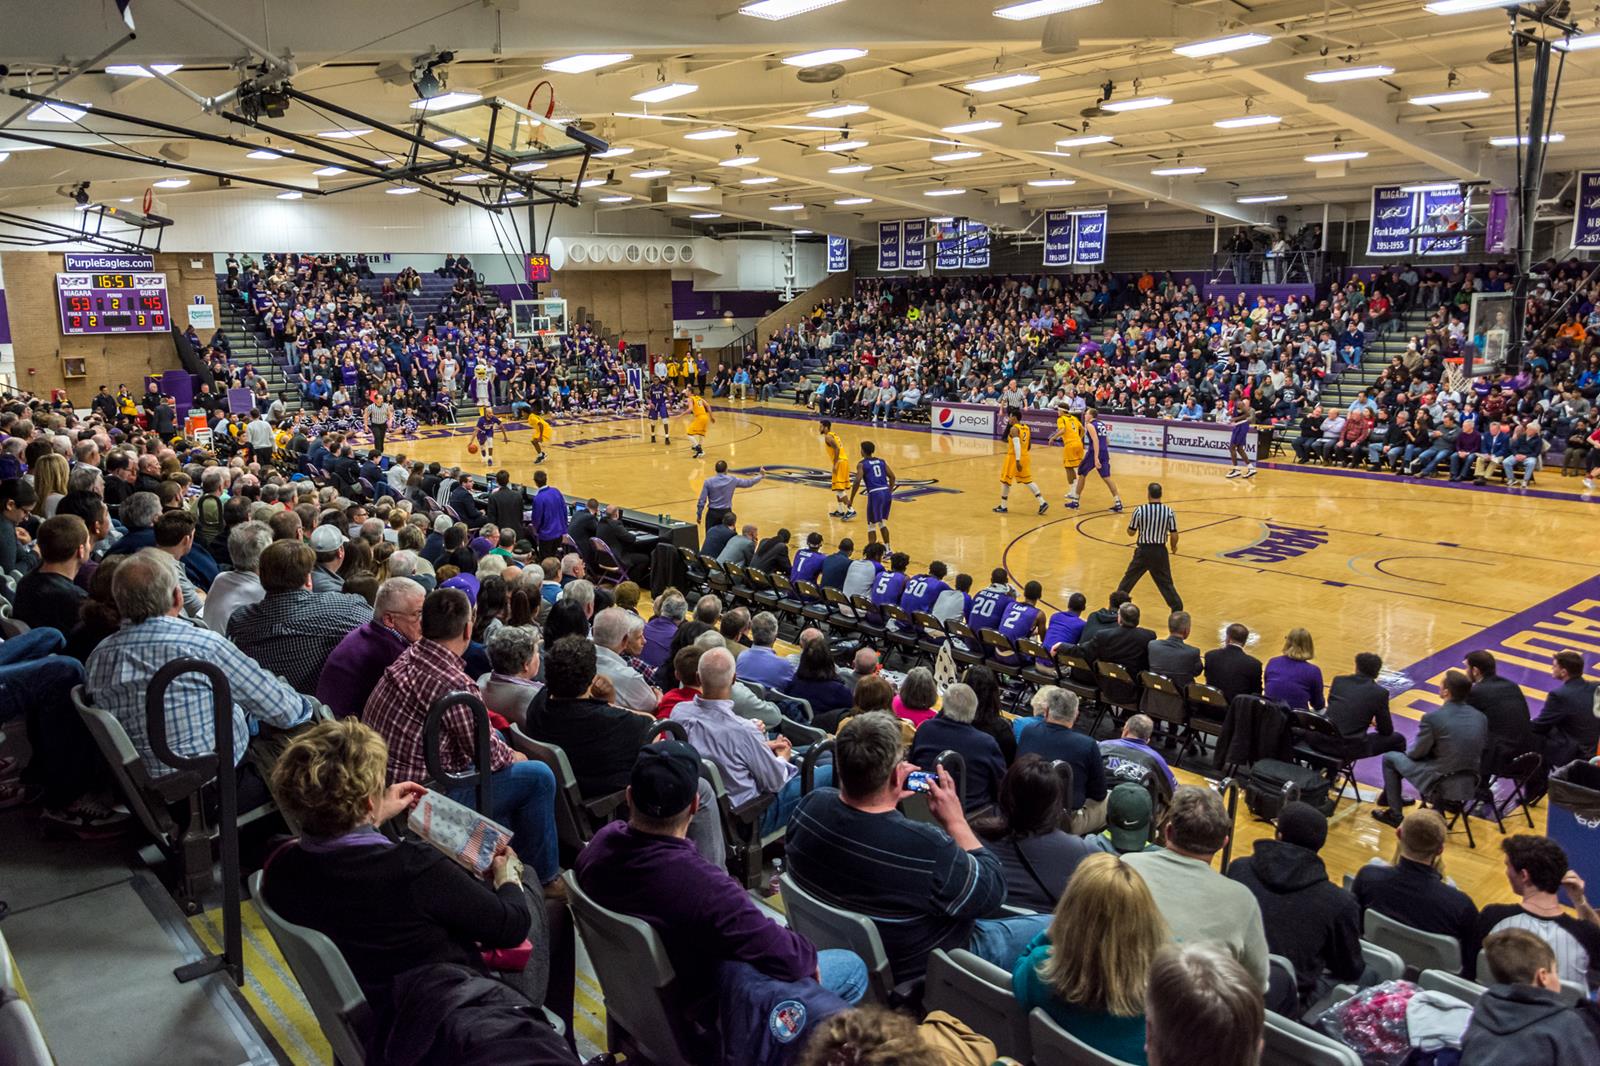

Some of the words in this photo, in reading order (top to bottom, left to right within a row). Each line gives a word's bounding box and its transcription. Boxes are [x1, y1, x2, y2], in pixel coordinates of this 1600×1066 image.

[1374, 227, 1388, 236] Frank
[1389, 227, 1409, 238] Layden
[68, 258, 152, 269] PurpleEagles.com
[346, 255, 380, 263] CEER
[99, 275, 133, 288] 16:51
[71, 297, 91, 311] 53
[112, 299, 119, 309] 2
[143, 297, 162, 310] 45
[73, 316, 80, 327] 2
[89, 316, 97, 326] 2
[138, 315, 145, 326] 3
[155, 314, 162, 325] 0
[959, 414, 989, 426] pepsi
[1097, 424, 1108, 436] 32
[1167, 433, 1256, 453] PURPLEEAGLESM
[873, 465, 881, 477] 0
[876, 578, 889, 594] 5
[905, 580, 928, 597] 30
[972, 597, 996, 617] 20
[1003, 611, 1021, 629] 2
